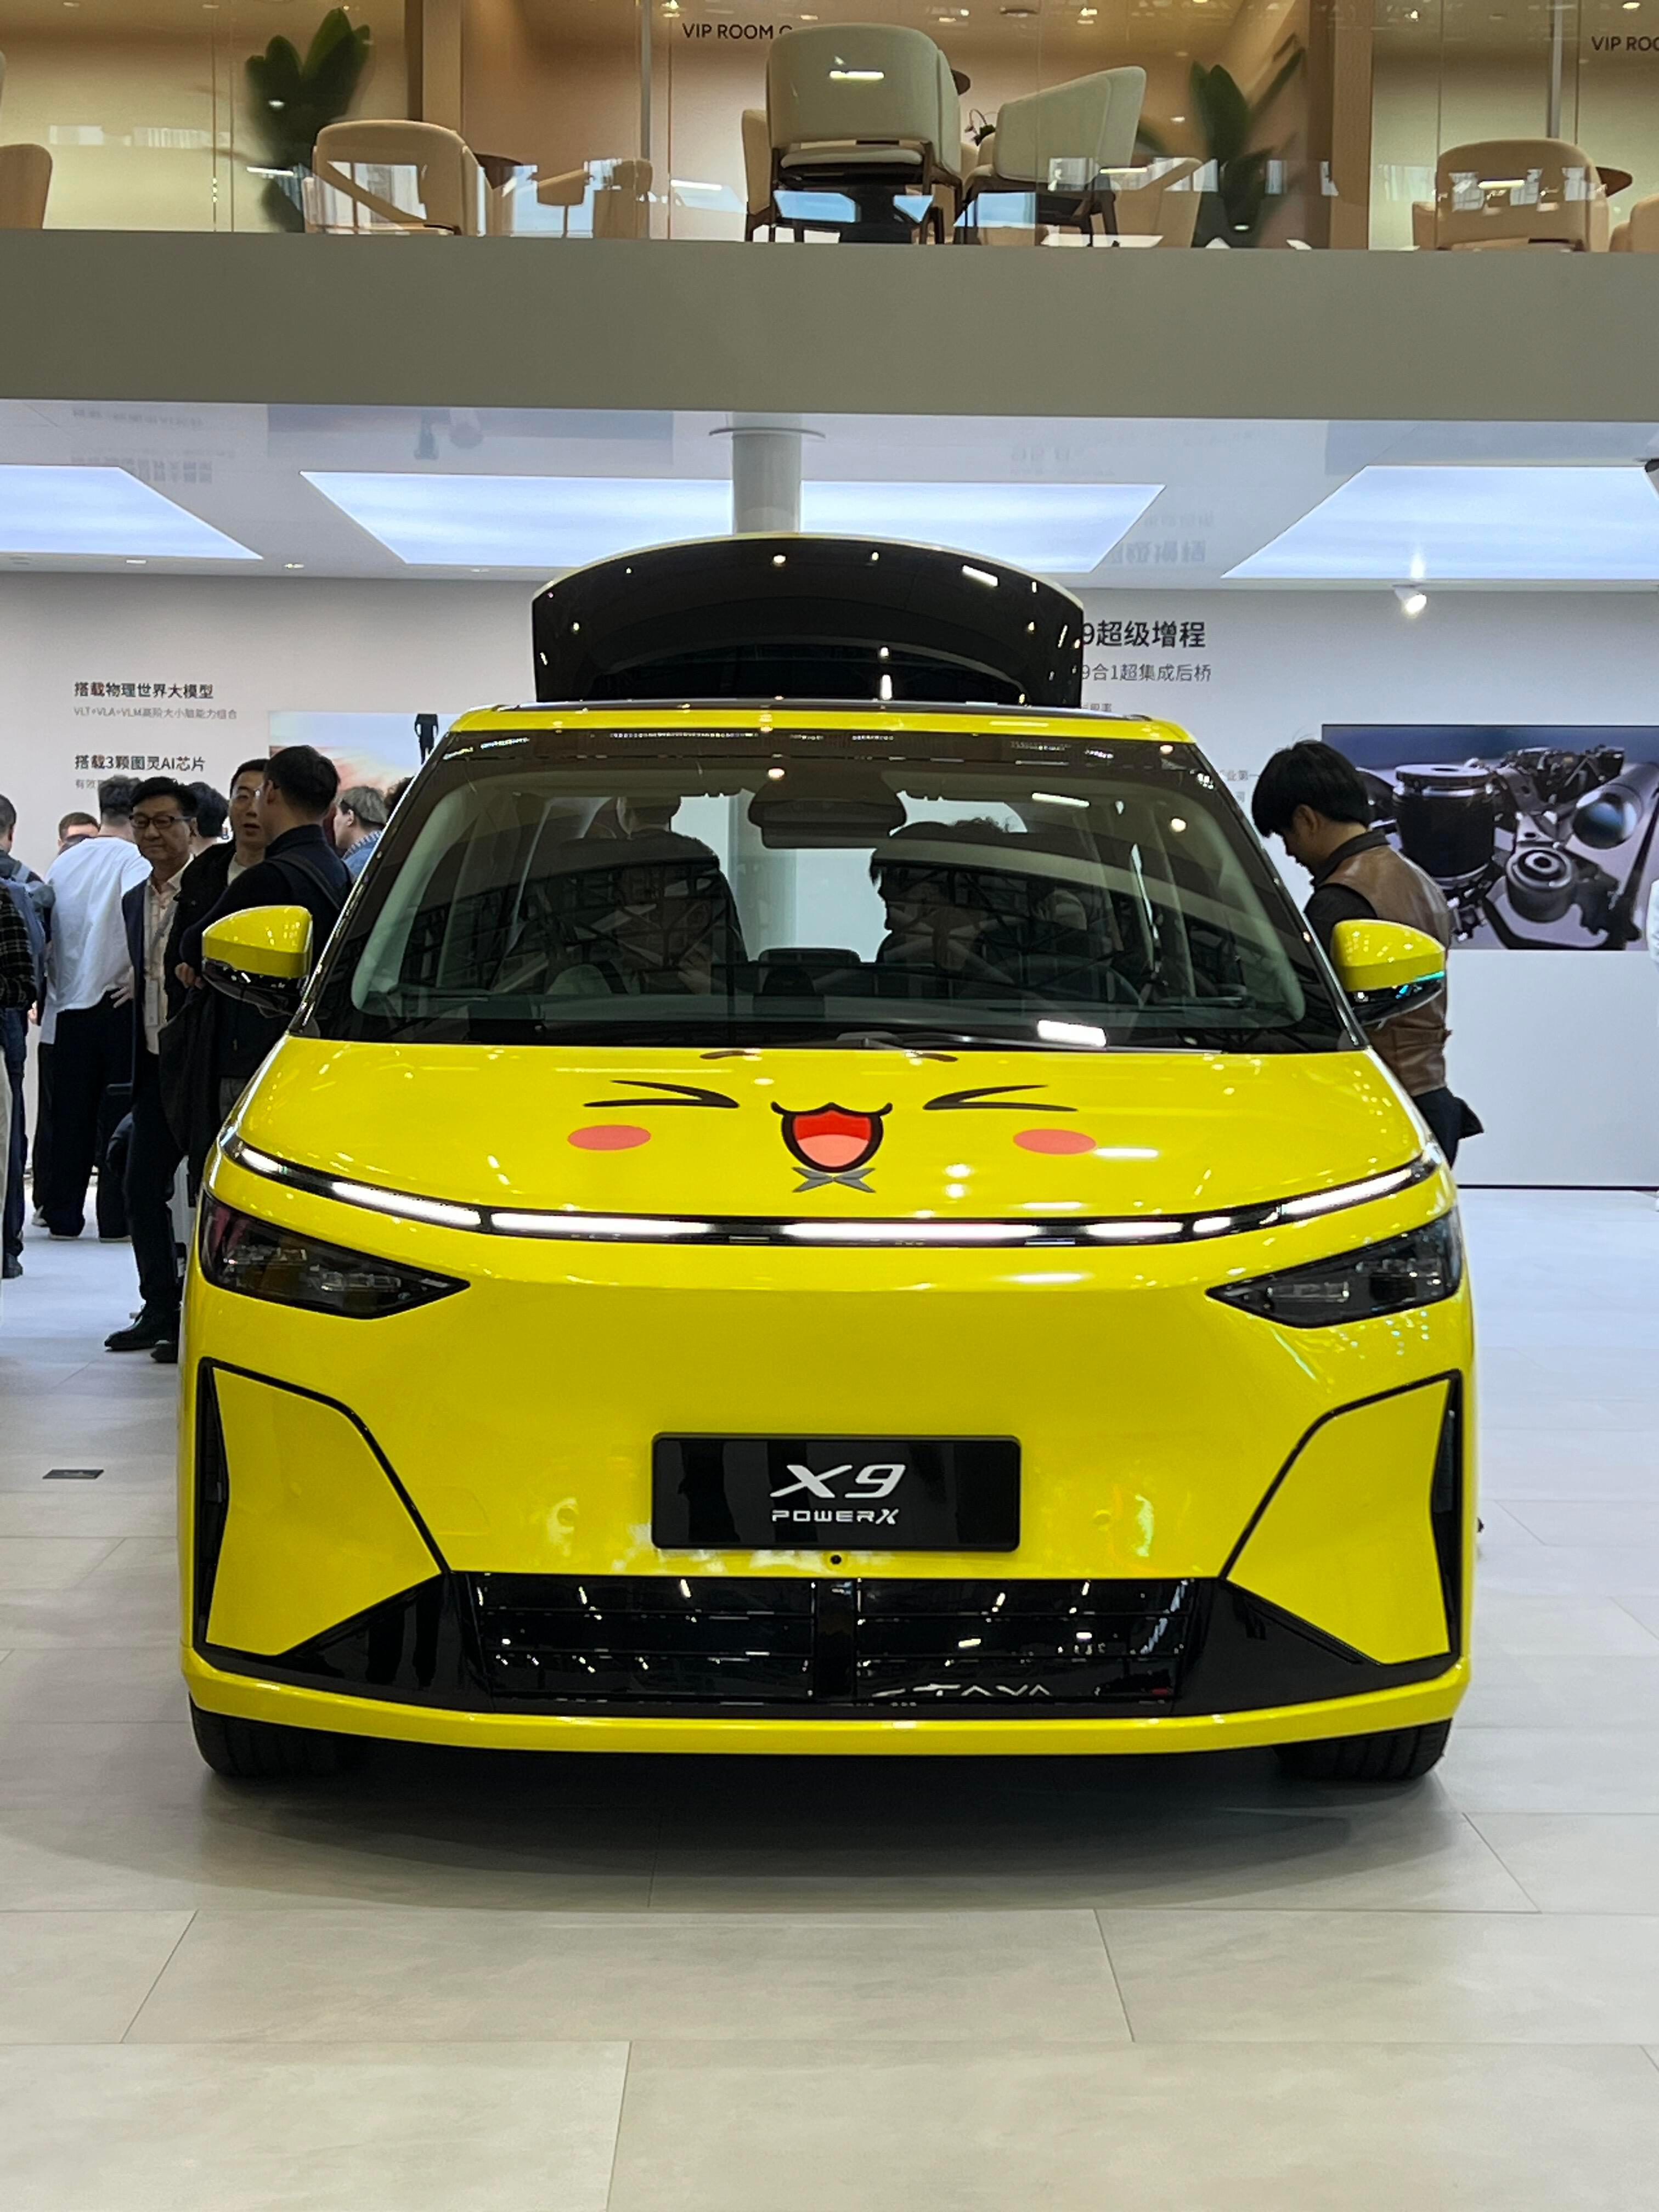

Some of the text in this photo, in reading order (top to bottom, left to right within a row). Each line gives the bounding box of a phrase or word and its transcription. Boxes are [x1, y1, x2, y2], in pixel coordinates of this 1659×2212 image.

[682, 23, 712, 38] VIP
[717, 24, 774, 40] ROOM
[1592, 35, 1622, 51] VIP
[1082, 620, 1206, 648] 9超级增程
[74, 681, 214, 699] 搭载物理世界大模型
[74, 755, 206, 772] 搭载3颗图灵AI芯片
[769, 1464, 906, 1498] X9
[771, 1509, 899, 1525] POWERX
